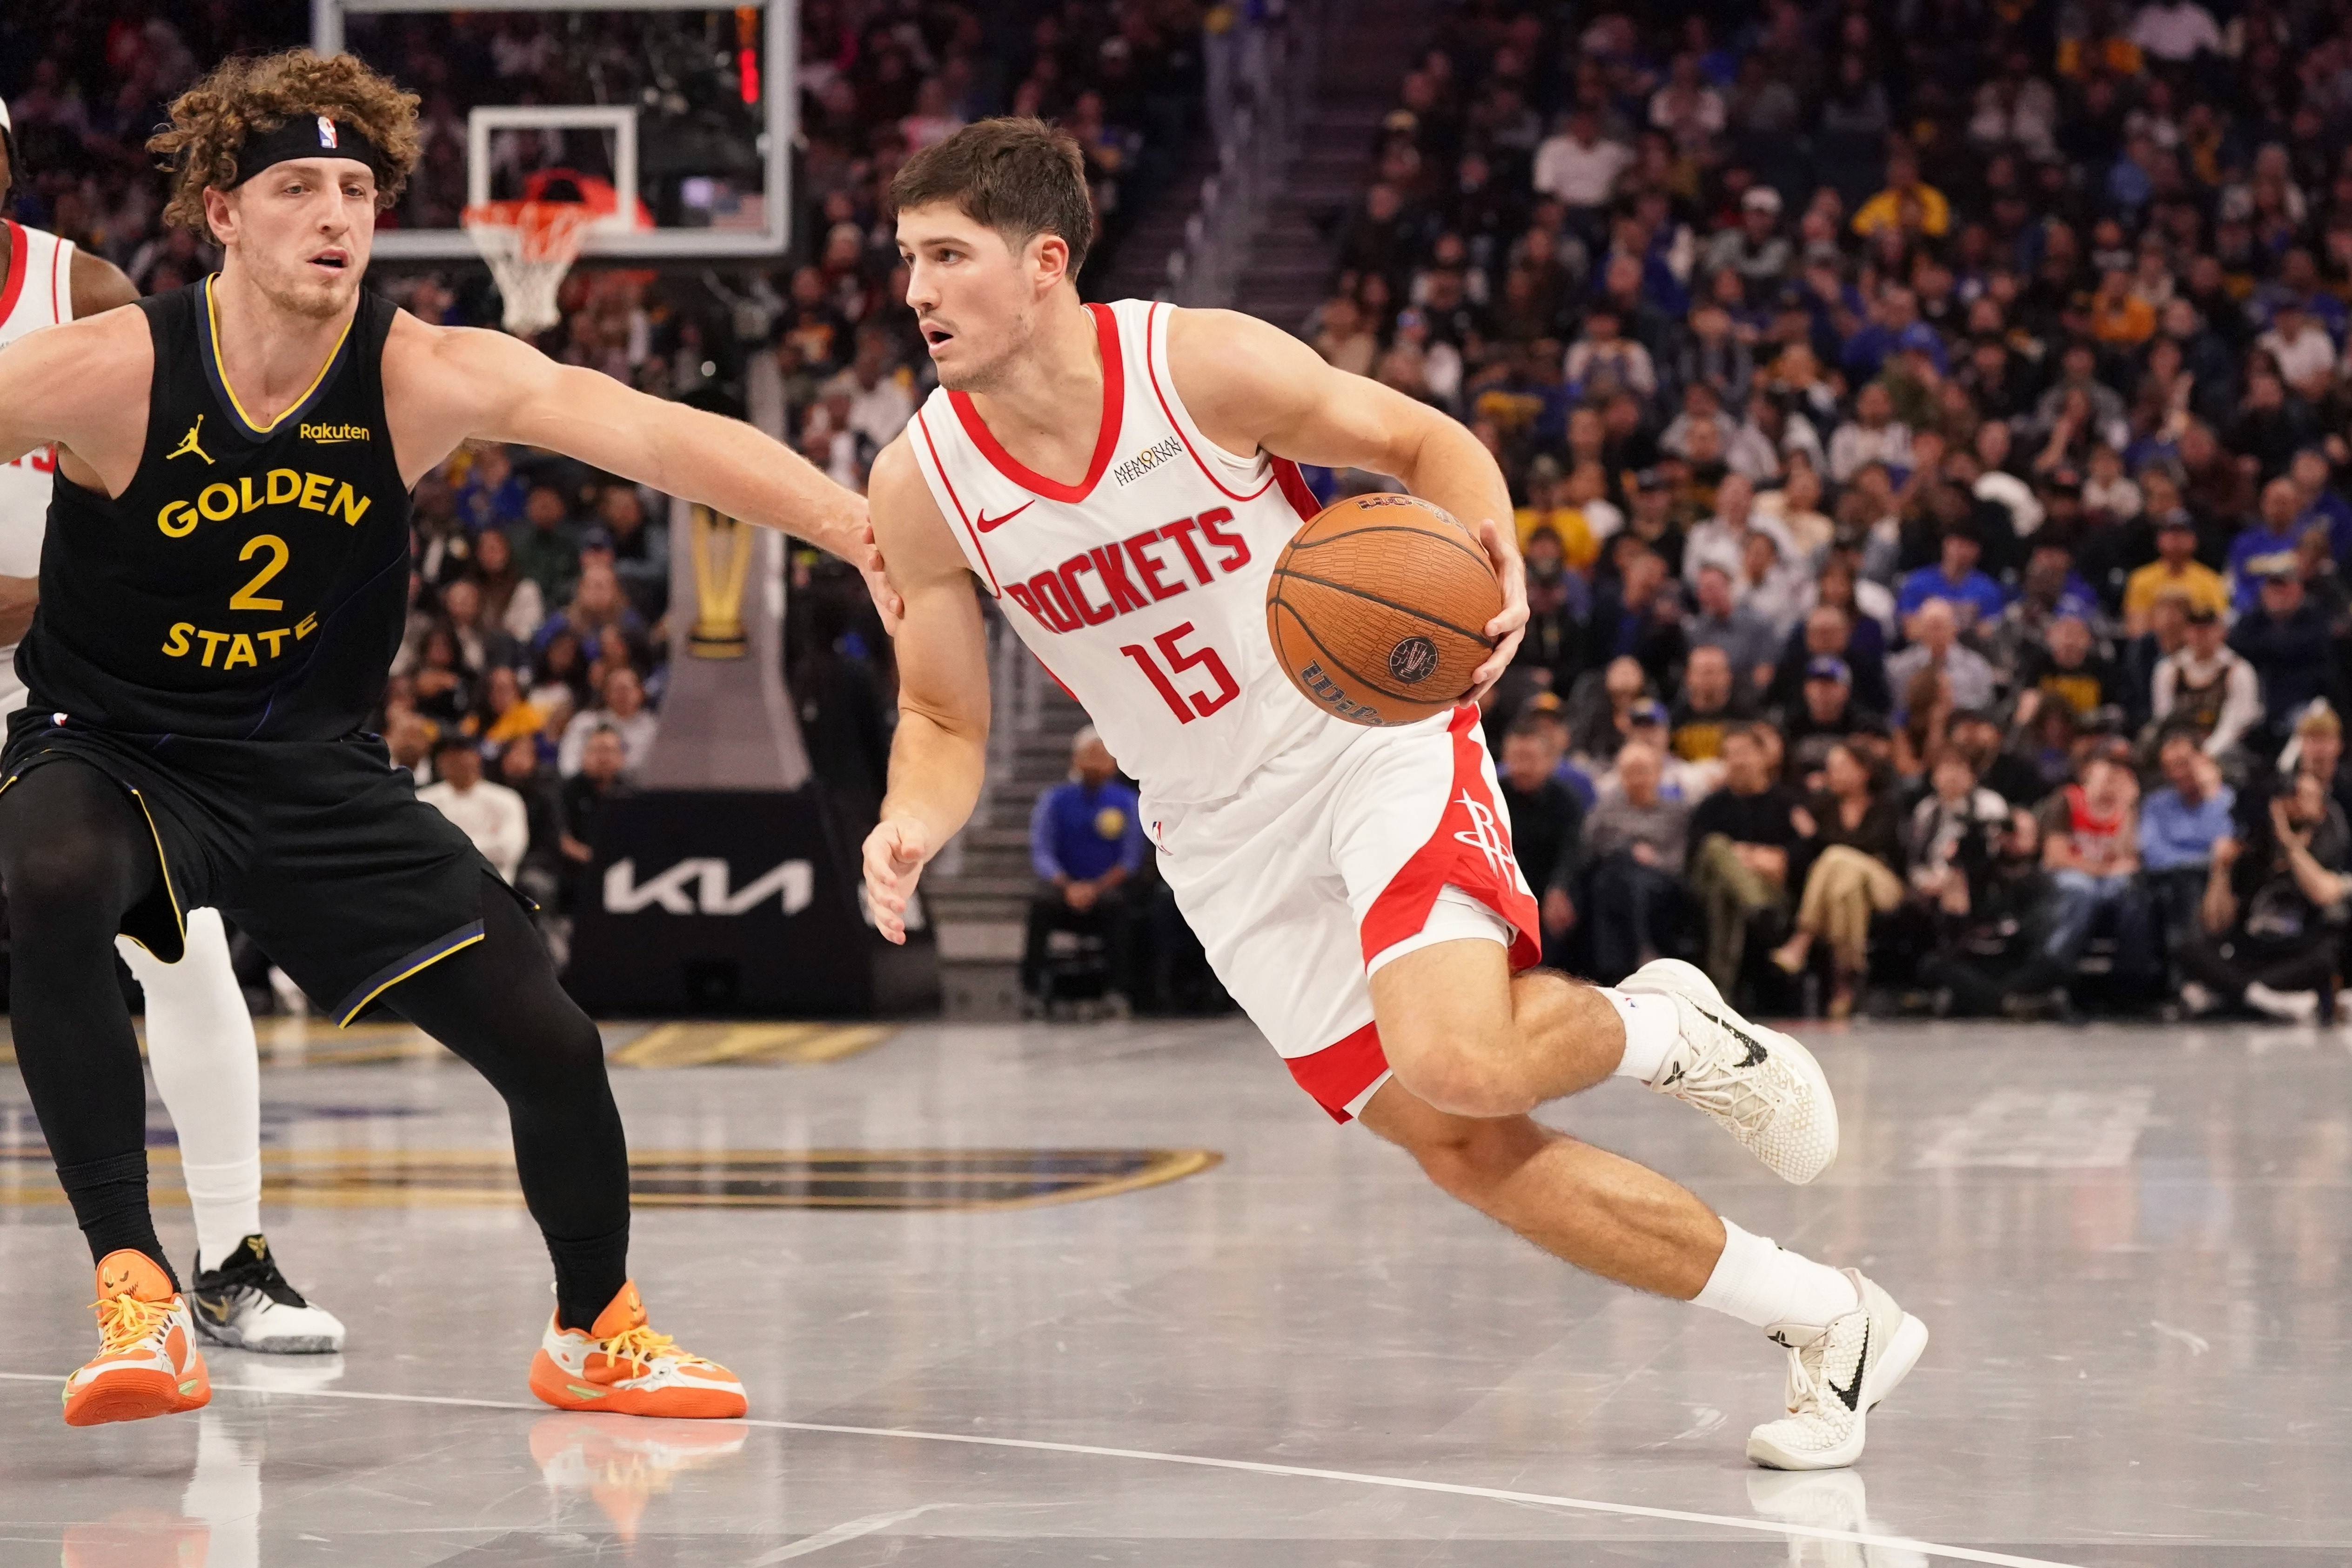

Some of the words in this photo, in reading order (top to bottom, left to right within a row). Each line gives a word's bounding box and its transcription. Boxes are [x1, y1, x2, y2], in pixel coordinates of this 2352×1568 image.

[300, 422, 370, 441] Rakuten
[1113, 436, 1179, 477] MEMORIAL
[1117, 442, 1183, 486] HERMANN
[157, 469, 371, 538] GOLDEN
[229, 534, 289, 611] 2
[1001, 506, 1252, 635] ROCKETS
[161, 611, 318, 670] STATE
[1119, 621, 1240, 724] 15
